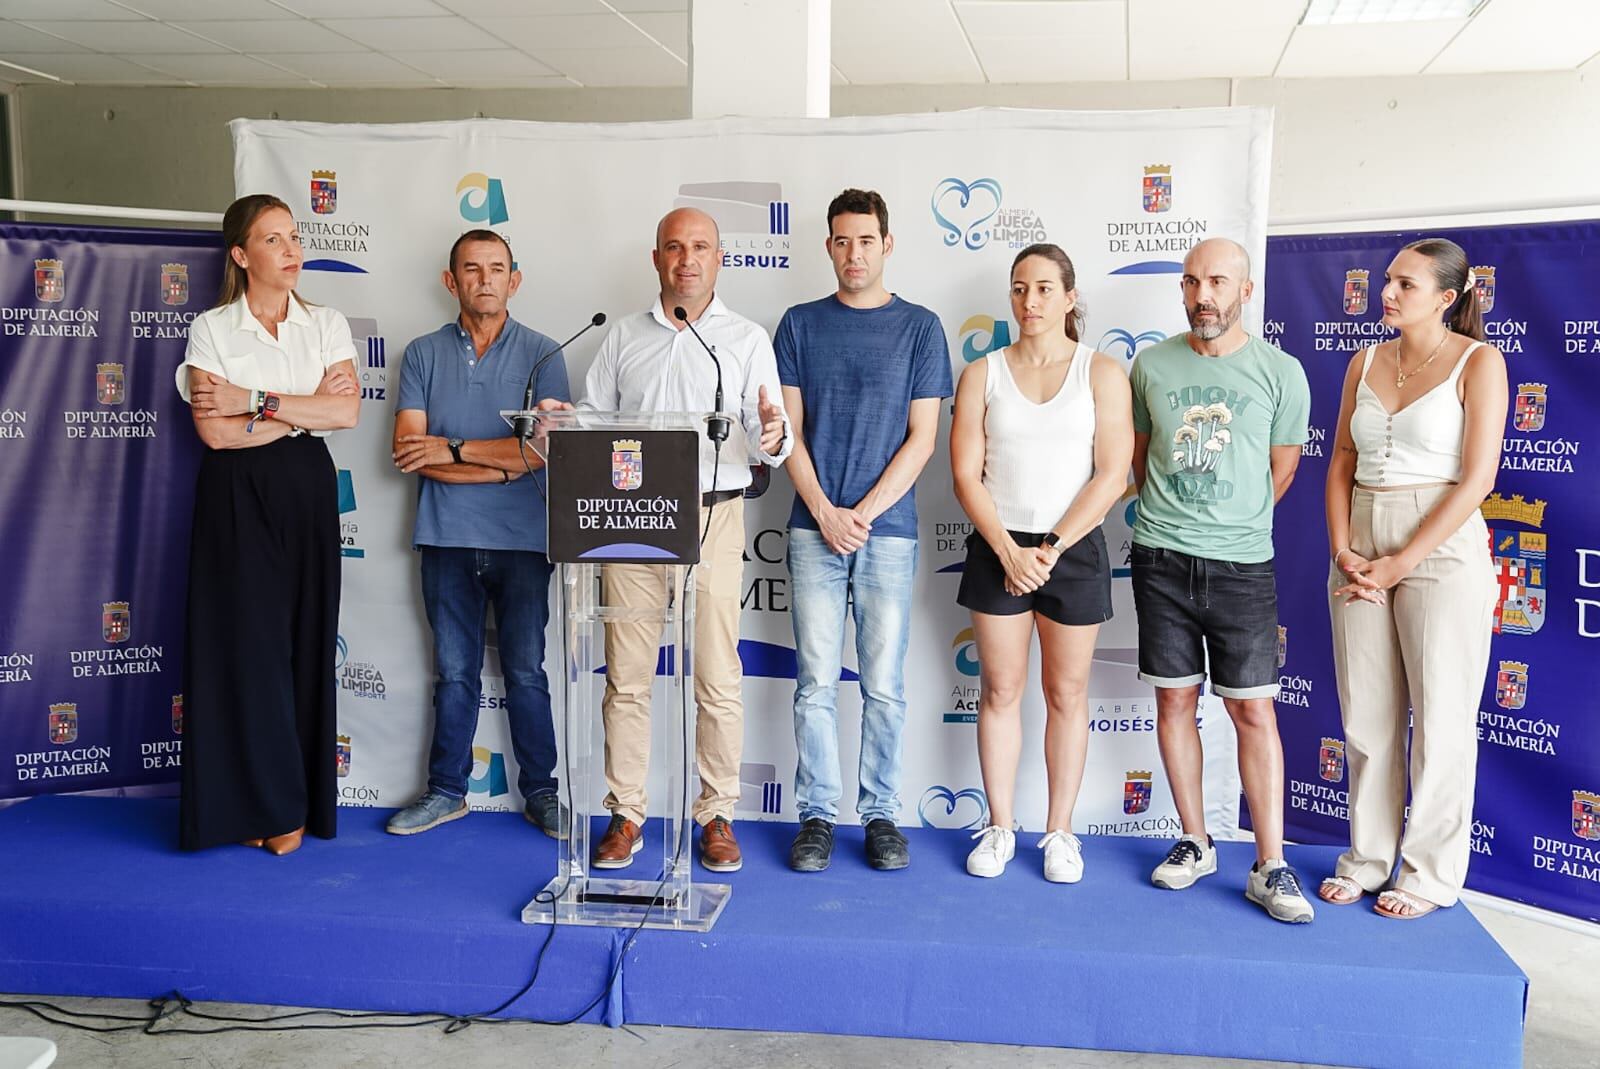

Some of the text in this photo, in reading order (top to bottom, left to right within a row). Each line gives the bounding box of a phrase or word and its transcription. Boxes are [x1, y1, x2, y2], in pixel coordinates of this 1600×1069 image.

[296, 221, 369, 237] IPUTACIÓN
[994, 215, 1044, 229] JUEGA
[1107, 217, 1207, 236] DIPUTACIÓN
[993, 228, 1047, 242] LIMPIO
[309, 237, 368, 252] ALMERÍA
[1109, 239, 1129, 252] DE
[722, 251, 789, 269] ÉSRUIZ
[2, 307, 99, 322] DIPUTACIÓN
[4, 321, 98, 338] DE ALMERÍA
[132, 326, 152, 339] DE
[1314, 319, 1395, 335] DIPUTACIÓN
[1315, 338, 1333, 351] DE
[1565, 339, 1587, 354] DE
[64, 408, 157, 424] DIPUTACIÓN
[67, 422, 156, 439] DE ALMERÍA
[1503, 437, 1580, 456] UTACIÓN
[1501, 455, 1574, 473] ALMERÍA
[576, 496, 679, 513] DIPUTACIÓN
[579, 512, 677, 530] DE ALMERÍA
[936, 539, 957, 552] DE
[70, 644, 163, 664] DIPUTACIÓN
[72, 660, 161, 679] DE ALMERÍA
[342, 667, 383, 682] JUEGA
[342, 678, 386, 694] LIMPIO
[354, 690, 386, 701] DEPORTE
[1487, 729, 1556, 756] ALMERÍA
[15, 745, 111, 766] DIPUTACIÓN
[143, 756, 162, 769] DE
[18, 760, 110, 781] DE ALMERÍA
[1291, 795, 1308, 811] DE
[1533, 853, 1556, 872] DE
